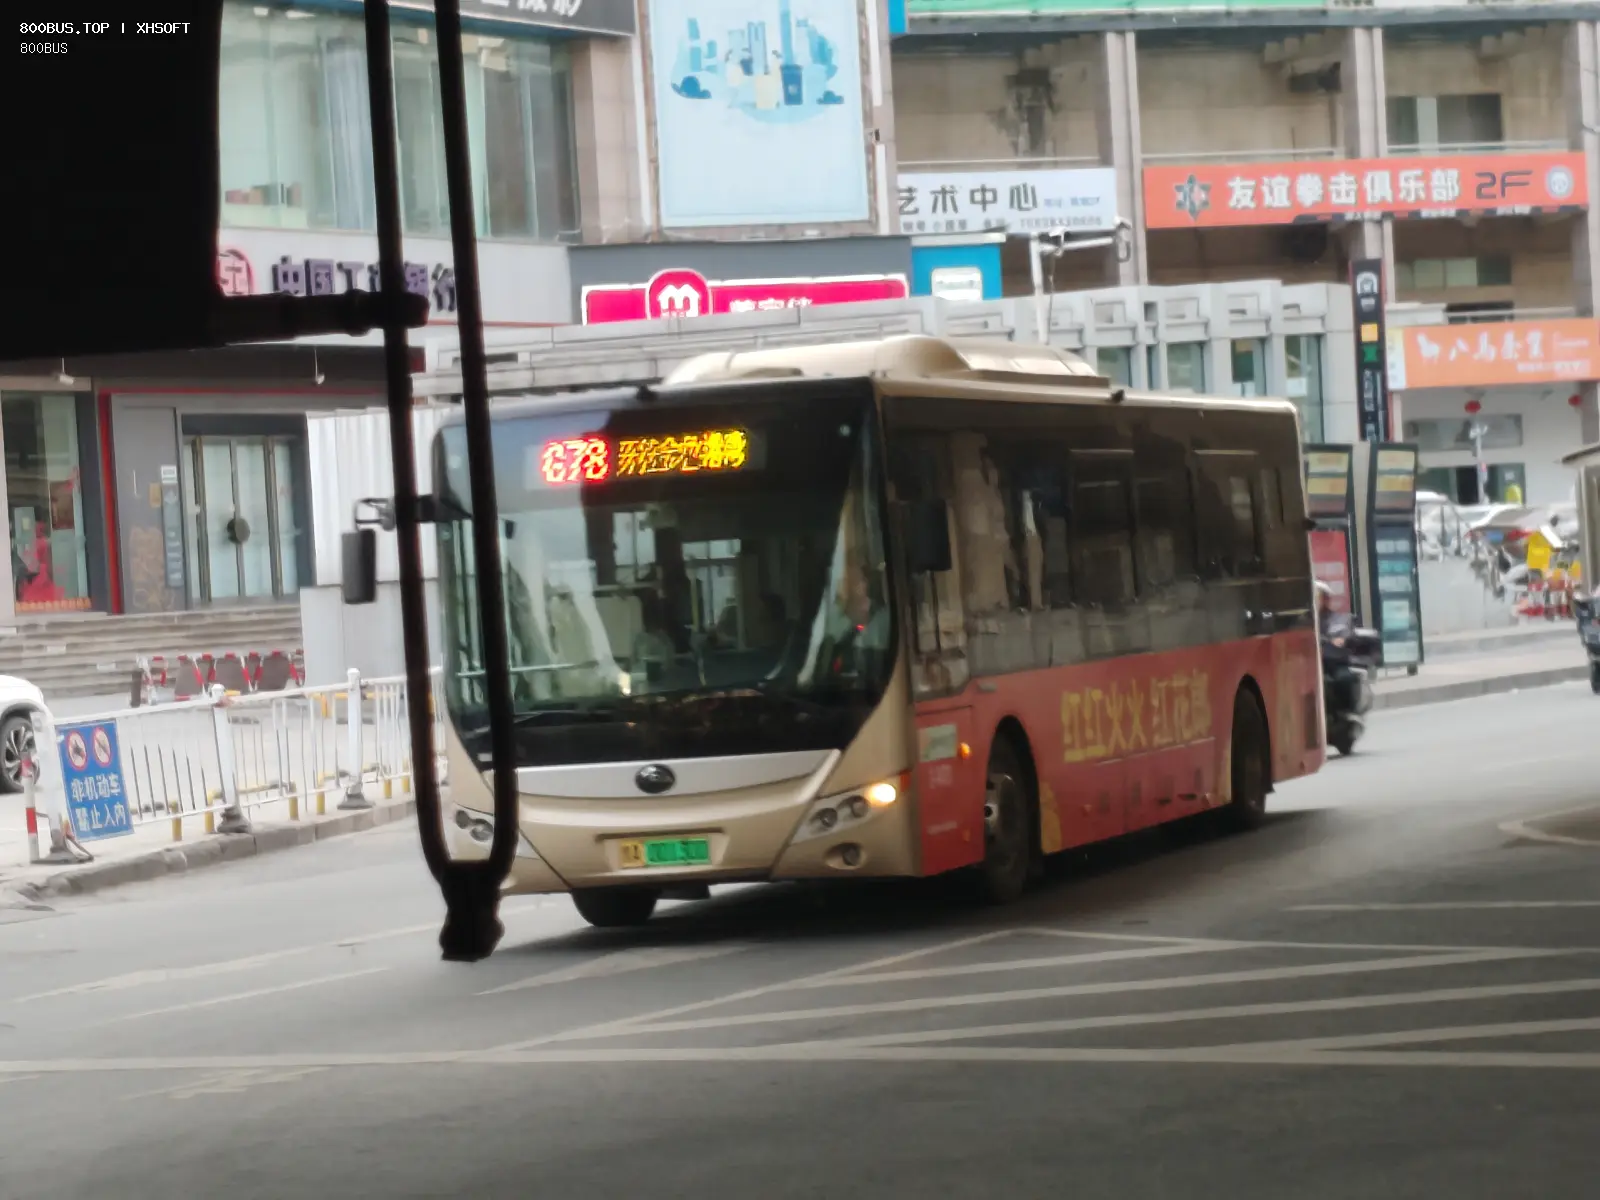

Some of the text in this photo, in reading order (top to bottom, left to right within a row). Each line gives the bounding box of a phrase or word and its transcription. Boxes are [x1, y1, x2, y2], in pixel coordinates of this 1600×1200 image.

[896, 182, 1039, 216] 艺术中心
[1227, 168, 1533, 210] 友谊拳击俱乐部 2F
[70, 772, 122, 803] 非机动车
[75, 801, 127, 832] 禁止入内
